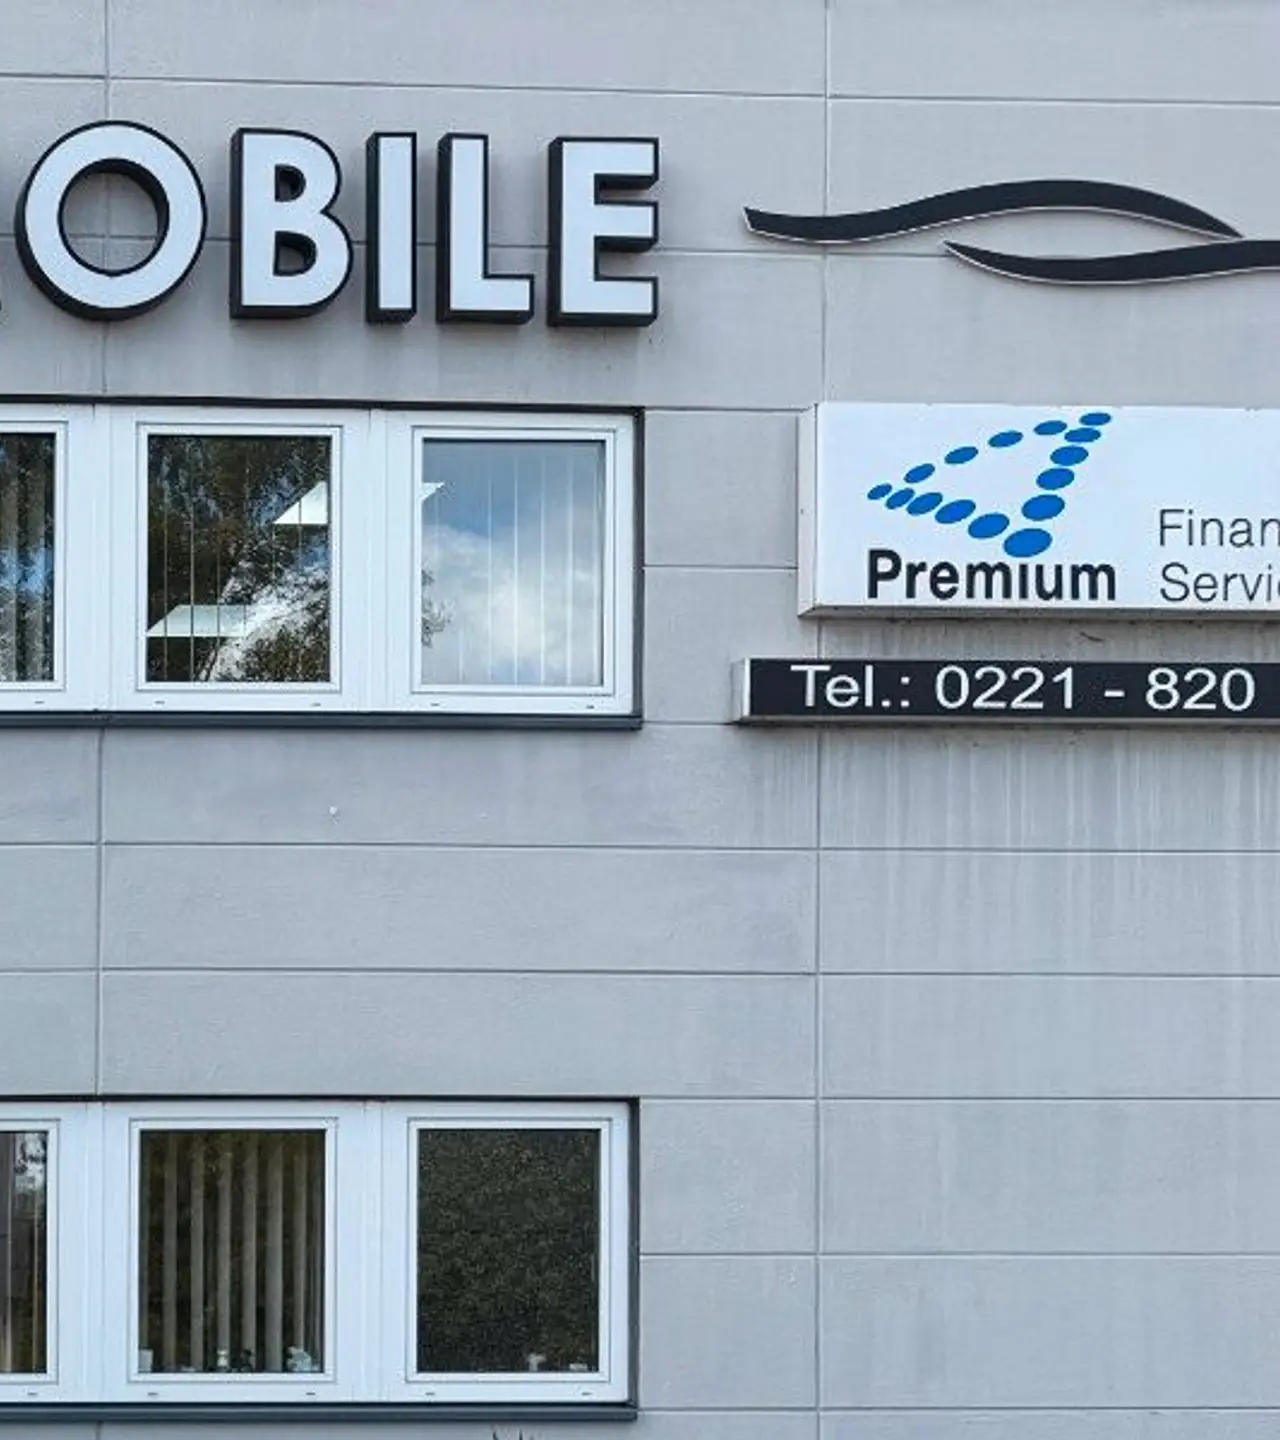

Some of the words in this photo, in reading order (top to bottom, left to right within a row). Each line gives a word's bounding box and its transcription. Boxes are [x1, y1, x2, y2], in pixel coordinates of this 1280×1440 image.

[867, 549, 1116, 600] Premium
[1160, 563, 1280, 601] Servi
[791, 664, 911, 710] Tel.:
[936, 666, 1074, 710] 0221
[1146, 668, 1255, 712] 820
